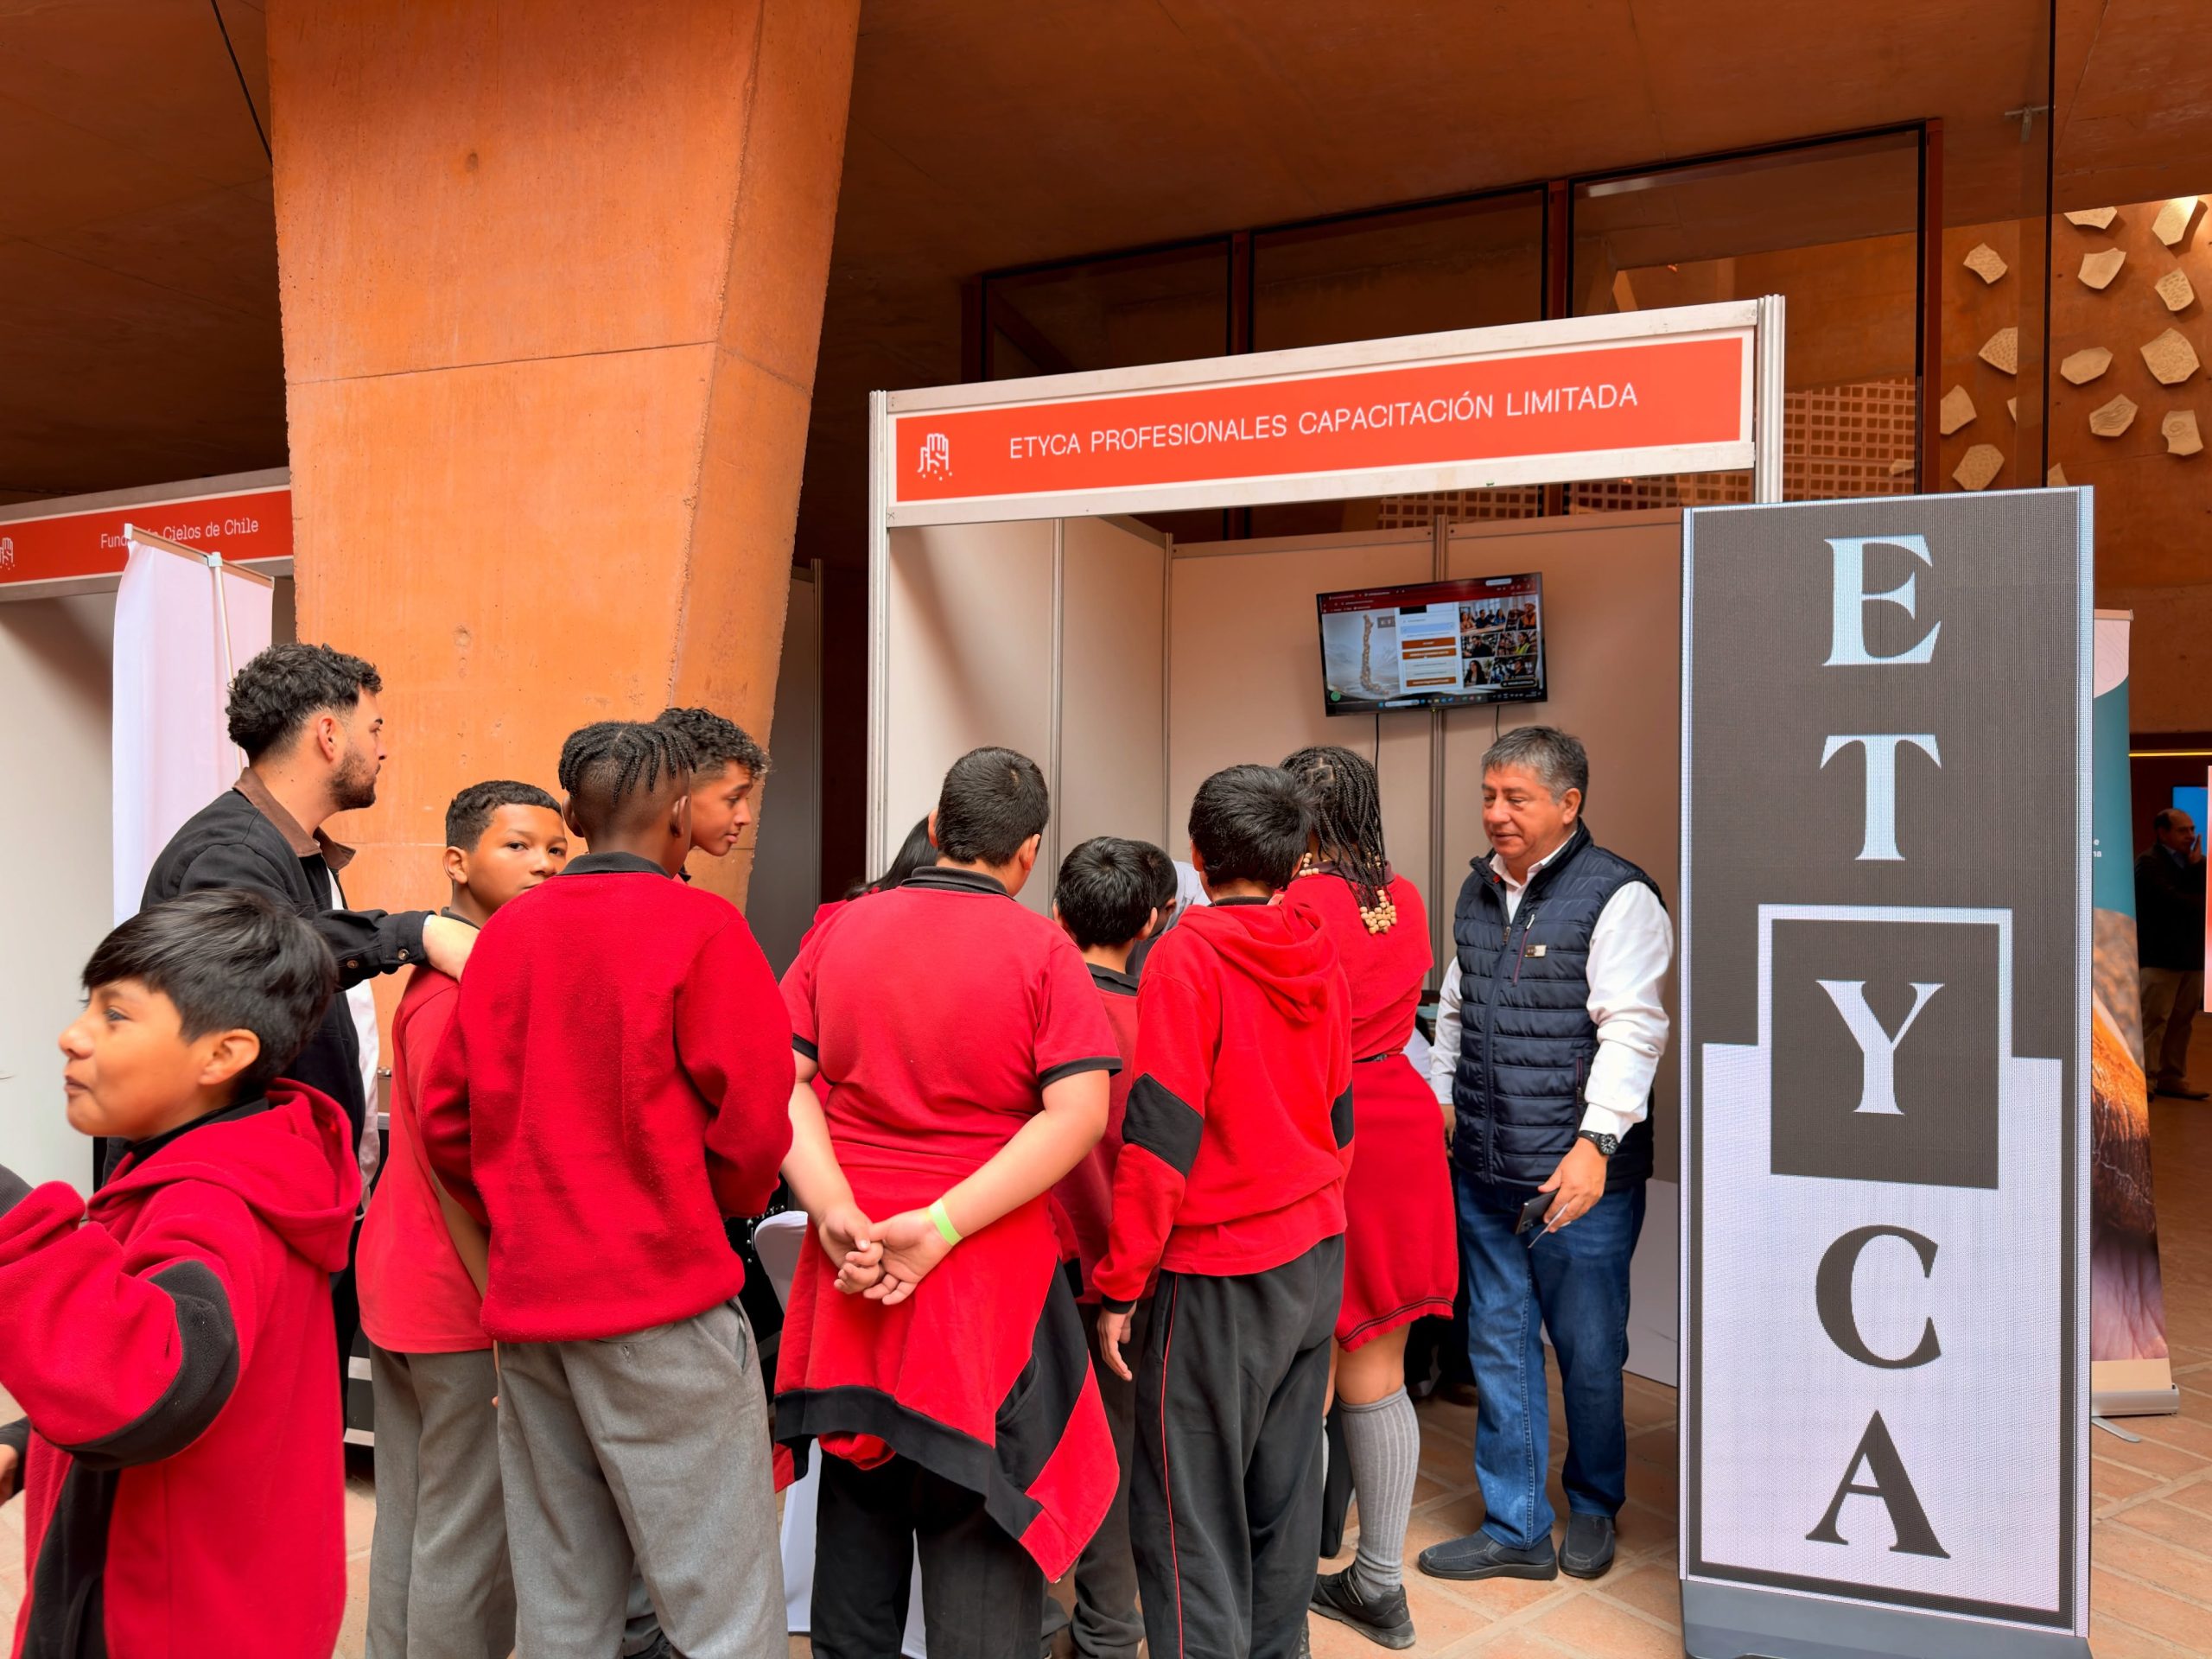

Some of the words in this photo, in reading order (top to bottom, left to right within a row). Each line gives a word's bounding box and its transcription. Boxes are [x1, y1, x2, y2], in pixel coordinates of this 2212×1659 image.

[1010, 433, 1081, 459] ETYCA
[1091, 414, 1287, 453] PROFESIONALES
[1299, 391, 1493, 435] CAPACITACIÓN
[1506, 382, 1638, 416] LIMITADA
[162, 524, 201, 541] Cielos
[206, 521, 220, 537] de
[225, 518, 259, 536] Chile
[1805, 533, 1951, 1559] ETYCA
